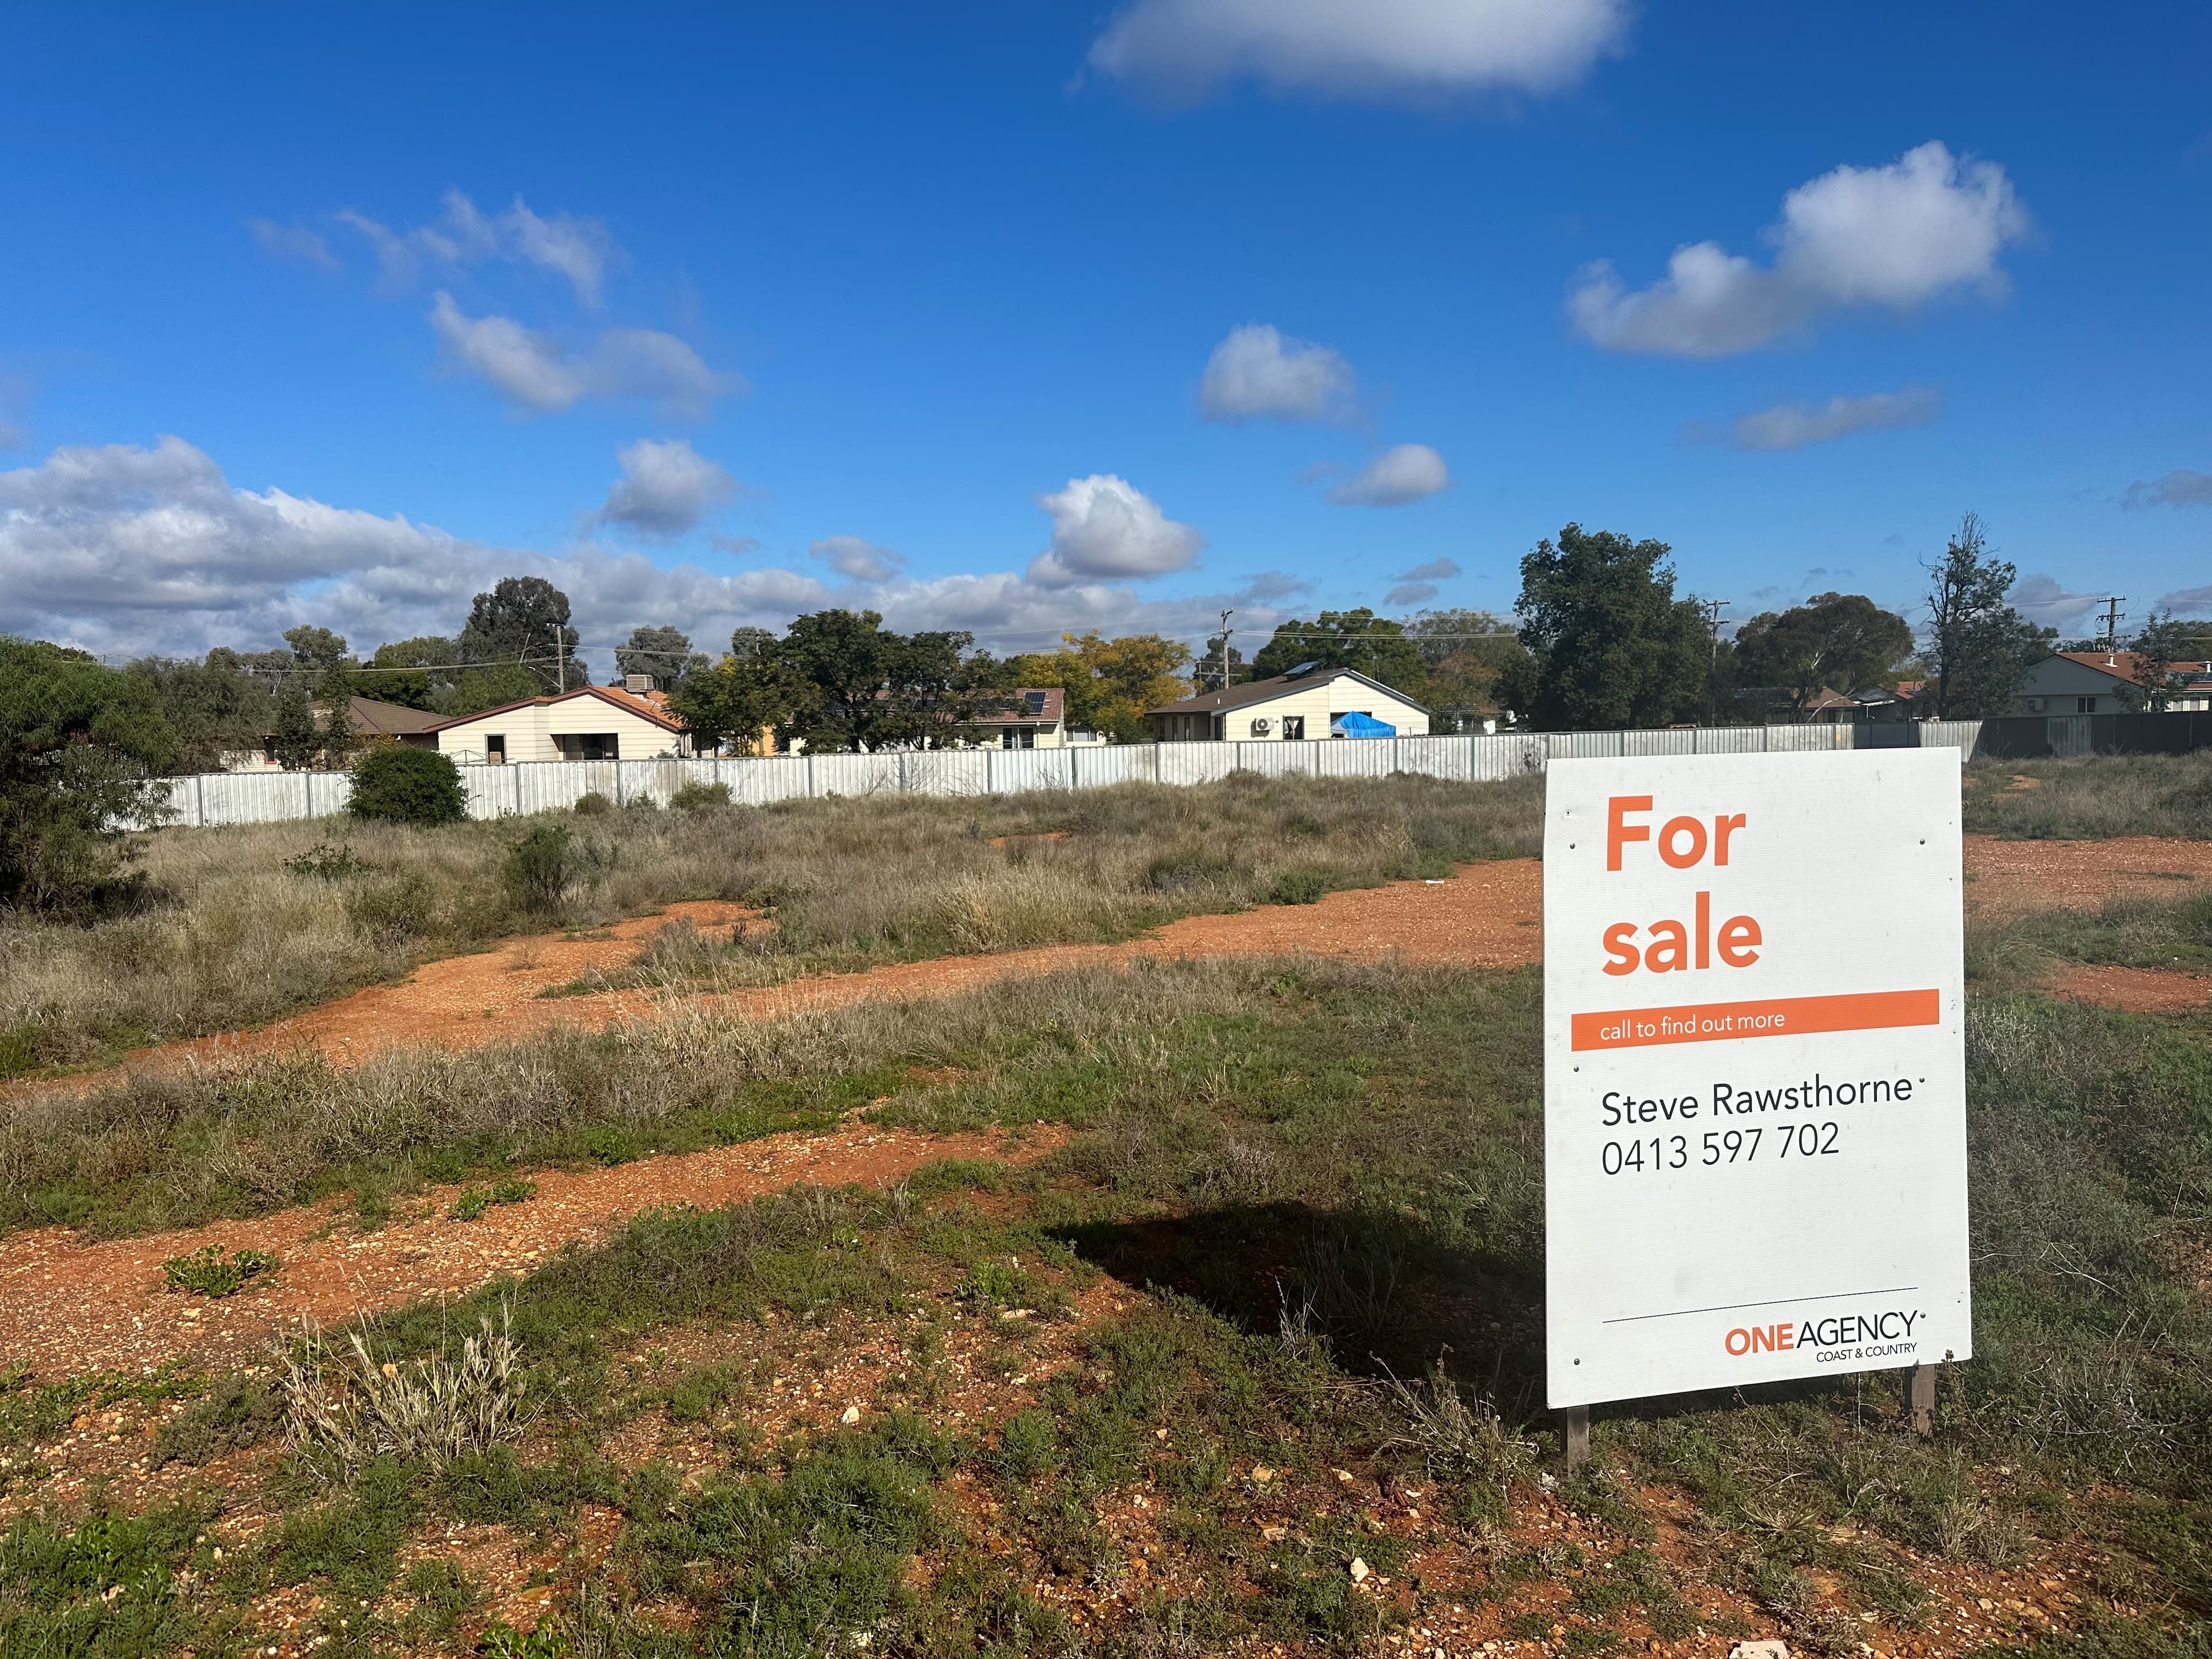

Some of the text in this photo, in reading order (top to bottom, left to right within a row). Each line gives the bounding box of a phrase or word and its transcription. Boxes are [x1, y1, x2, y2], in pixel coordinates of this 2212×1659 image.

[1607, 795, 1746, 872] For
[1602, 891, 1762, 976] sale
[1600, 1014, 1785, 1040] call to find out more
[1602, 1073, 1912, 1126] Steve Rawsthorne
[1602, 1122, 1839, 1175] 0413 597 702
[1816, 1342, 1917, 1363] COAST & COUNTRY
